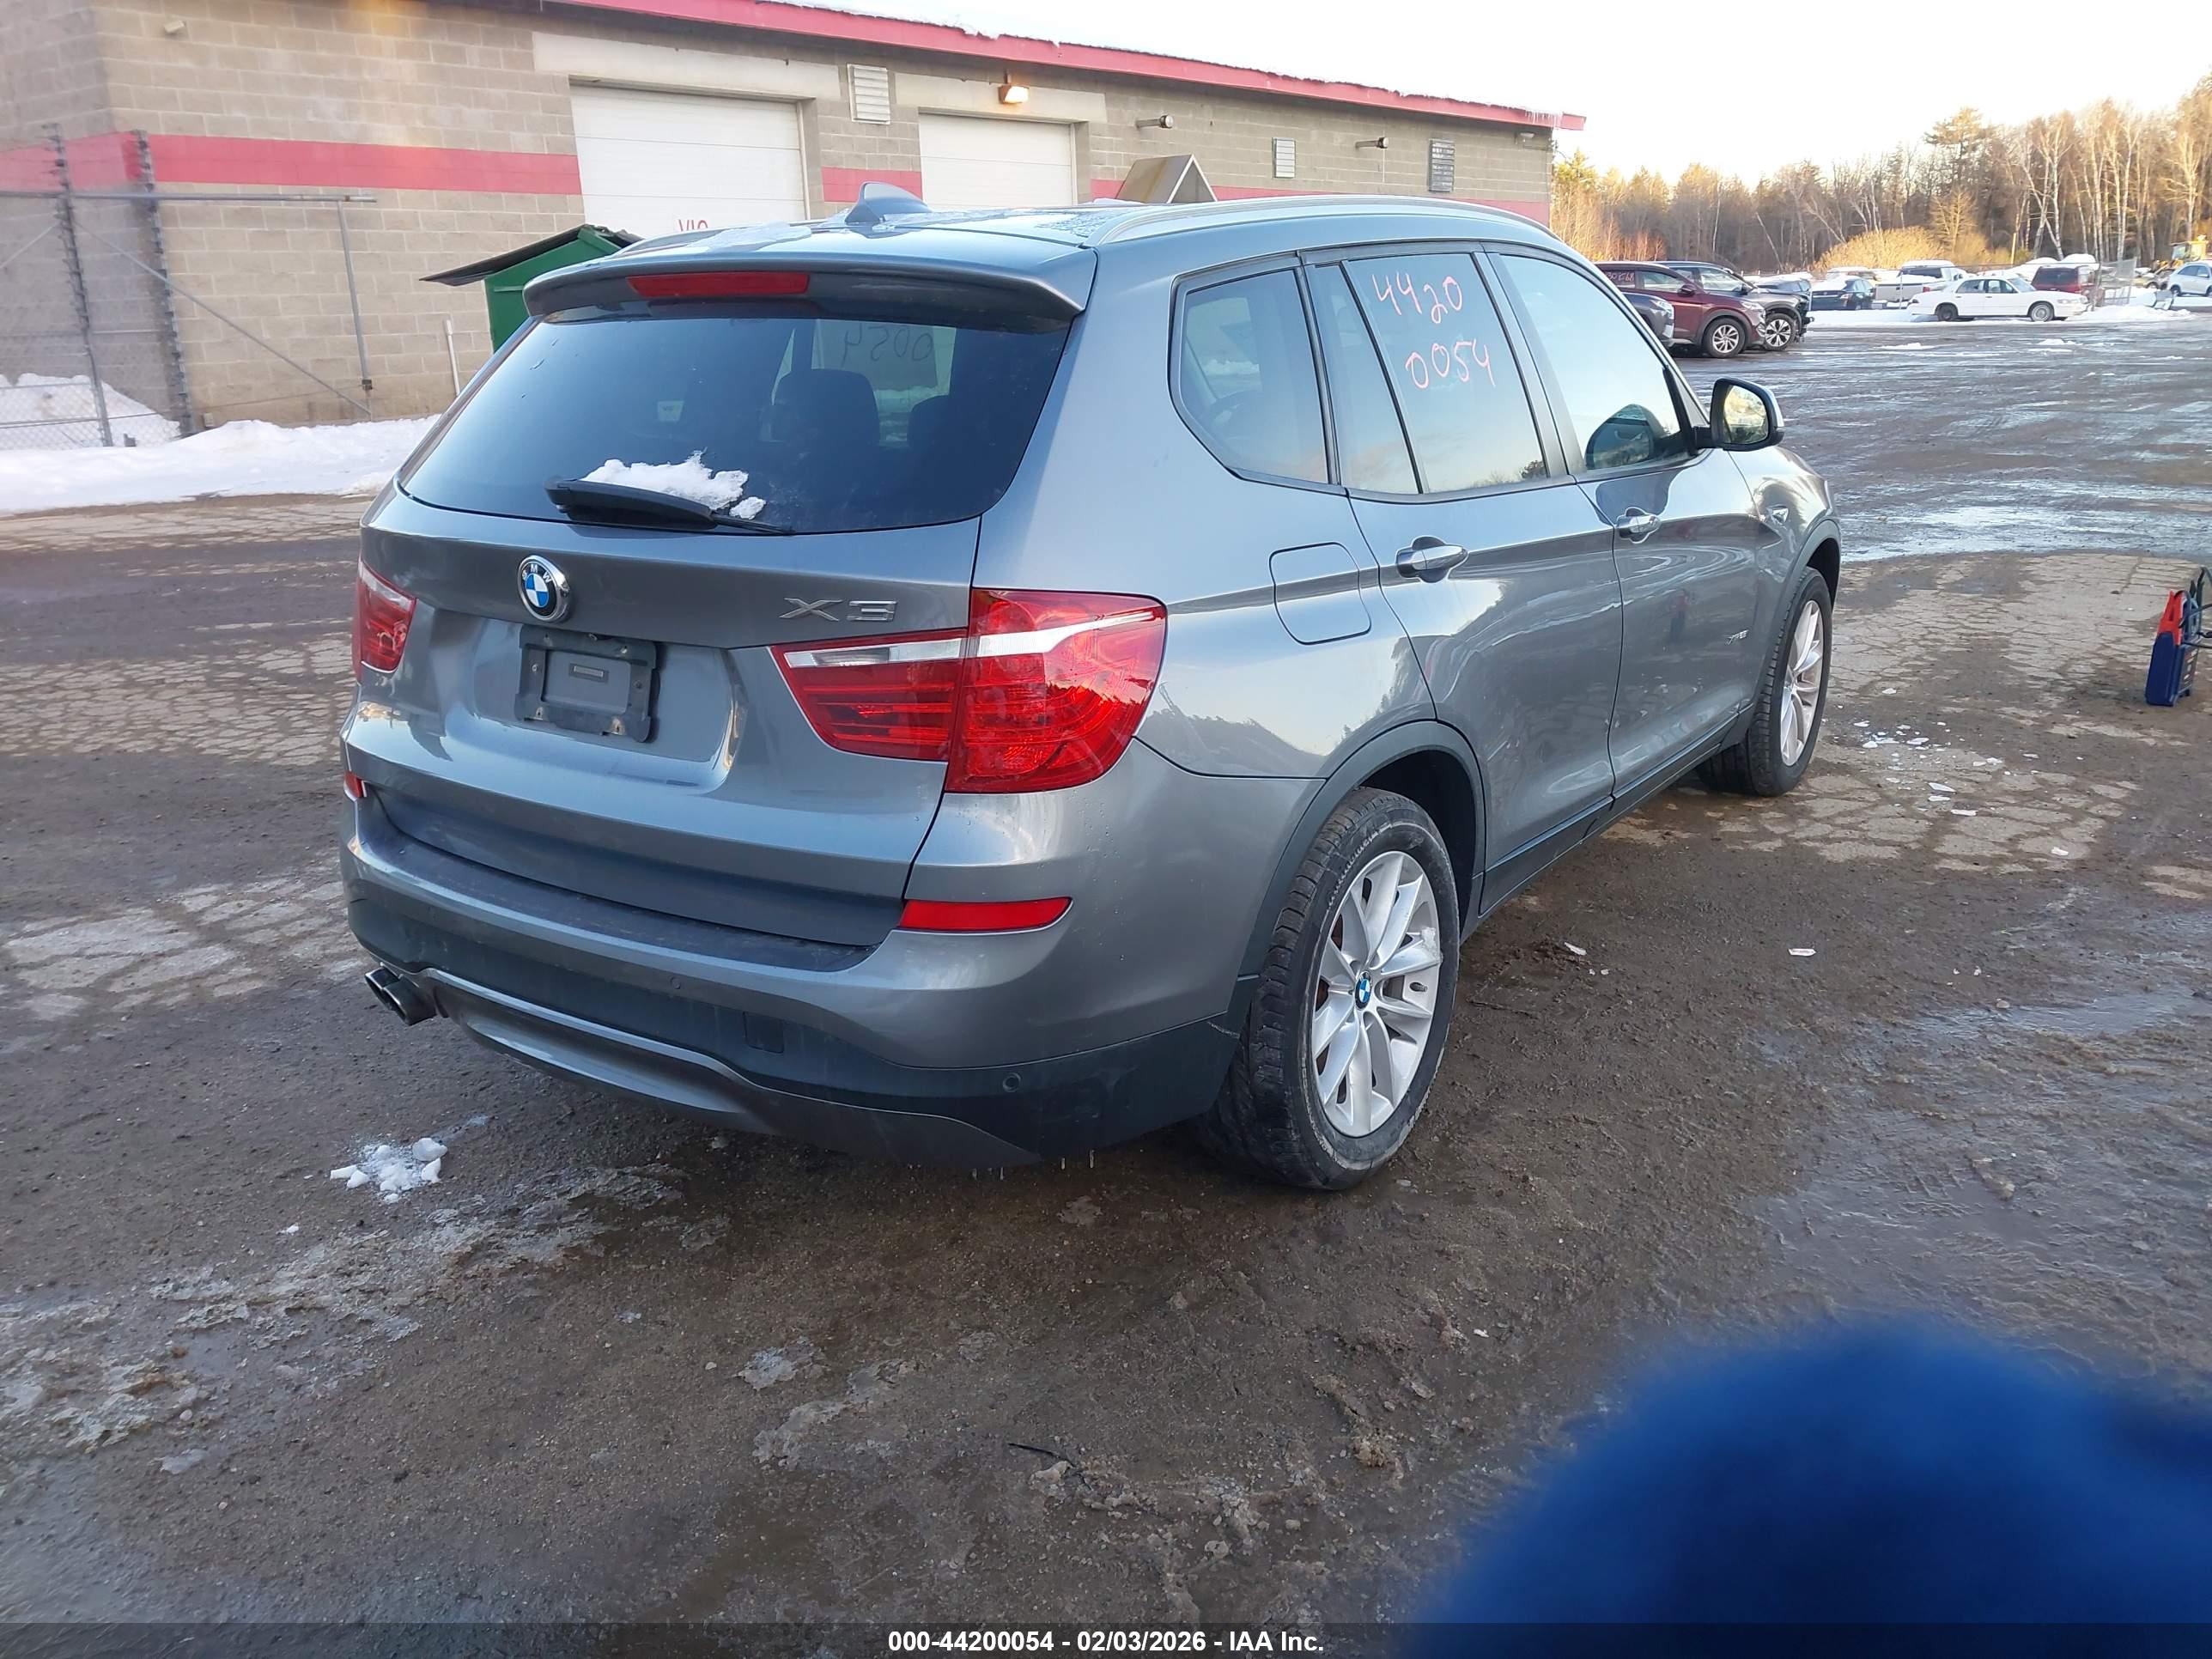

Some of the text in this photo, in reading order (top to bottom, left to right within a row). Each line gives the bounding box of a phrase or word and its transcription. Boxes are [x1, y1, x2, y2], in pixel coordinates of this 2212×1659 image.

[1371, 271, 1462, 324] 4420
[1405, 338, 1497, 389] 0054
[779, 598, 897, 621] X3
